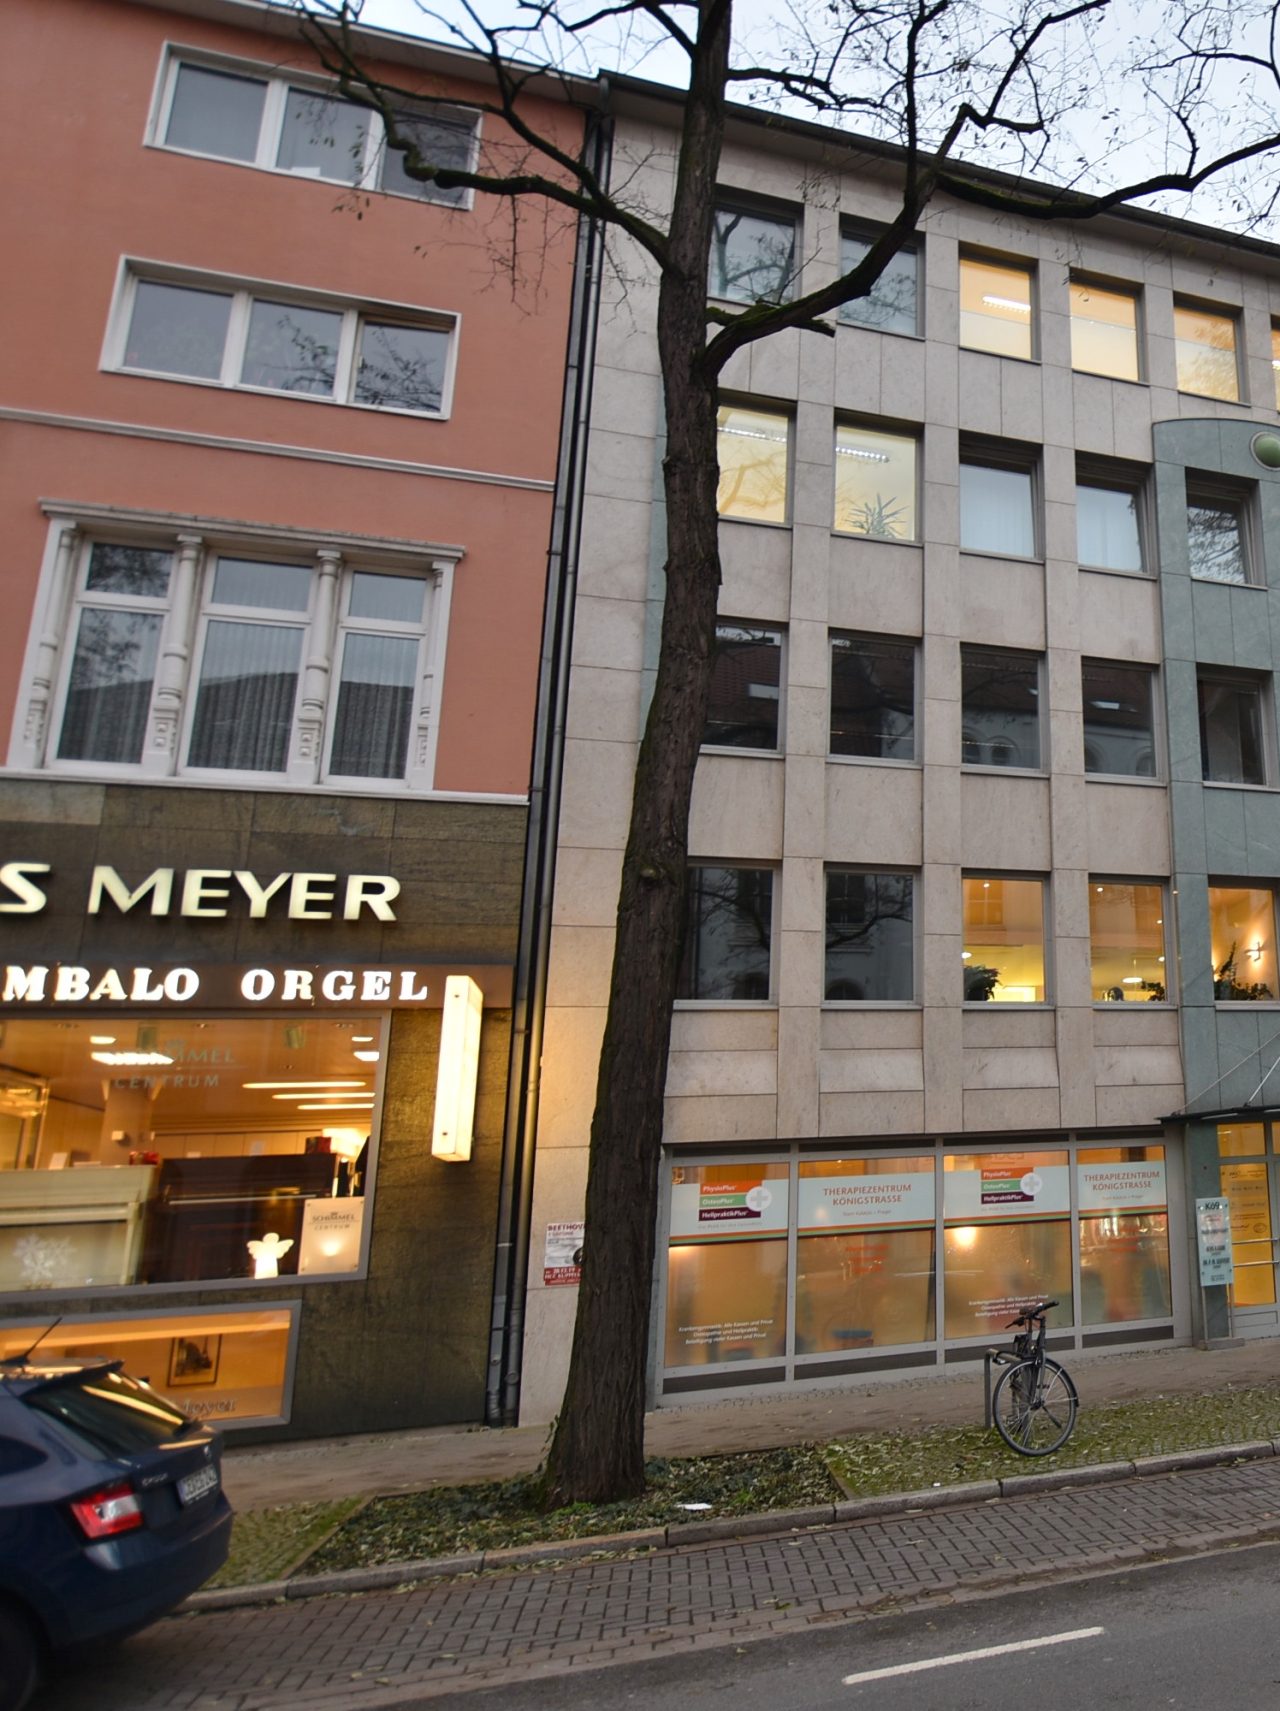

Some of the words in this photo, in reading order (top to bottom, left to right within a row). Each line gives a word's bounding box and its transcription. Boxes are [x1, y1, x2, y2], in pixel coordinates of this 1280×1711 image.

[88, 866, 401, 922] MEYER
[2, 966, 200, 1001] MBALO
[241, 969, 429, 1001] ORGEL
[114, 1073, 220, 1089] CENTRUM
[1083, 1170, 1161, 1182] THERAPIEZENTRUM
[702, 1184, 737, 1193] PhysioPlus
[823, 1183, 912, 1196] THERAPIEZENTRUM
[1092, 1180, 1153, 1192] KÖNIGSTRASSE
[832, 1194, 903, 1206] KÖNIGSTRASSE
[701, 1210, 749, 1220] HeilpraktikPlus
[548, 1223, 585, 1232] BEETHOV
